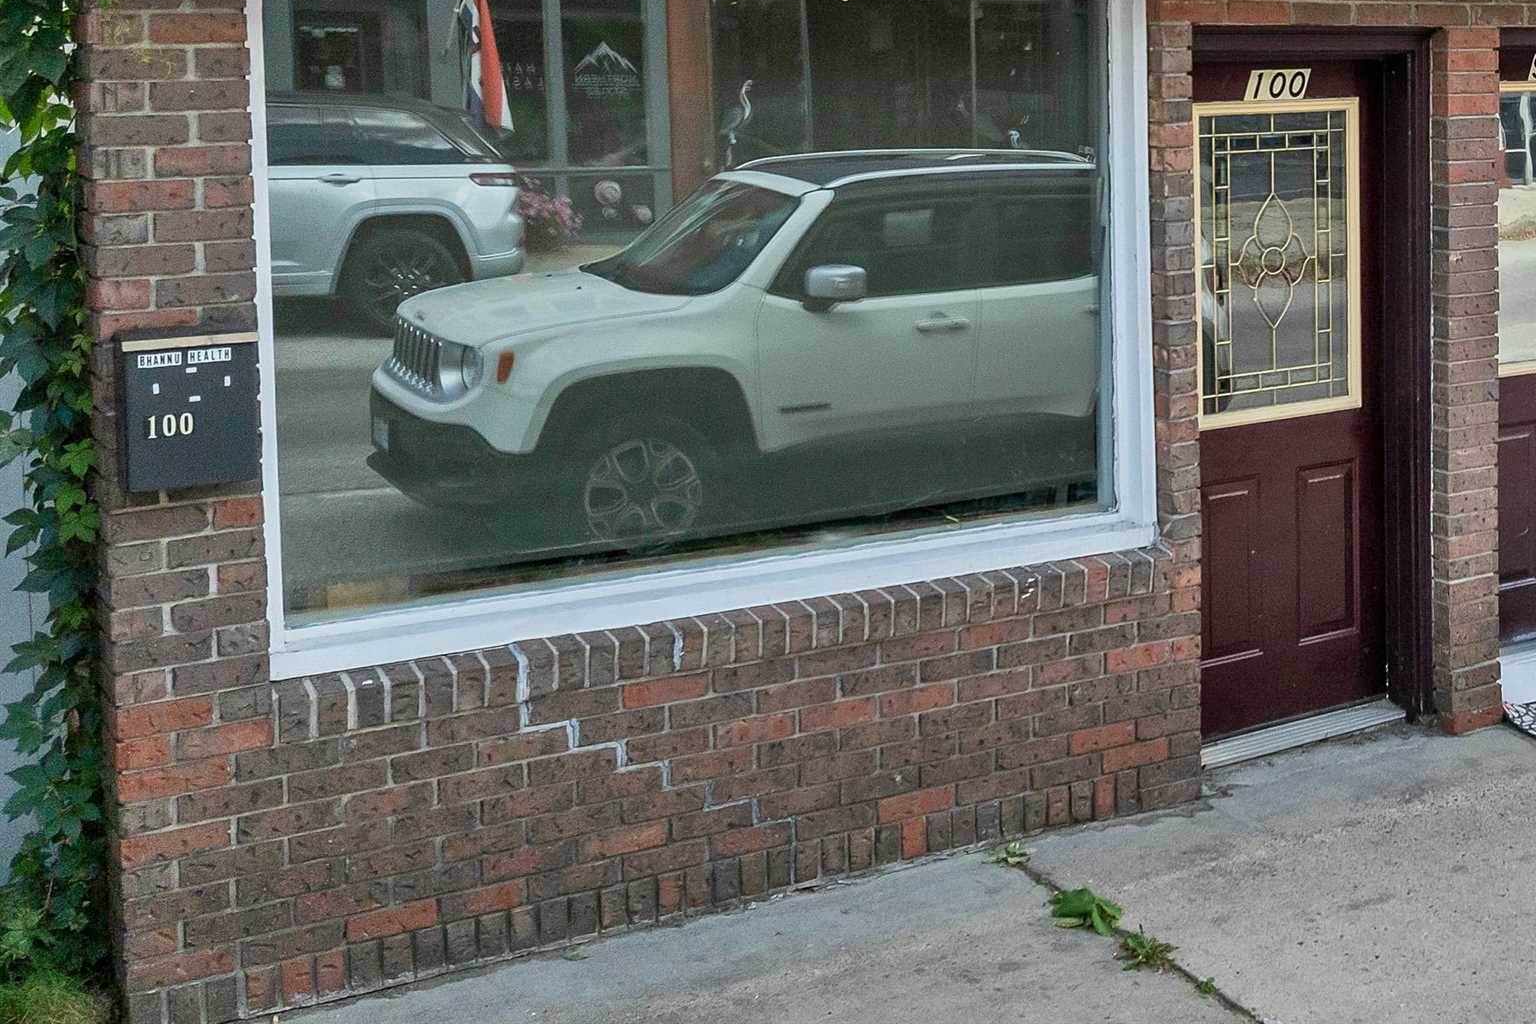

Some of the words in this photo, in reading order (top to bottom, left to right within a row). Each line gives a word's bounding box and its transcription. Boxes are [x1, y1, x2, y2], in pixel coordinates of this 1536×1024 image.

[1253, 71, 1306, 99] 100
[140, 353, 180, 366] BHANNU
[190, 349, 230, 362] HEALTH
[147, 413, 194, 439] 100
